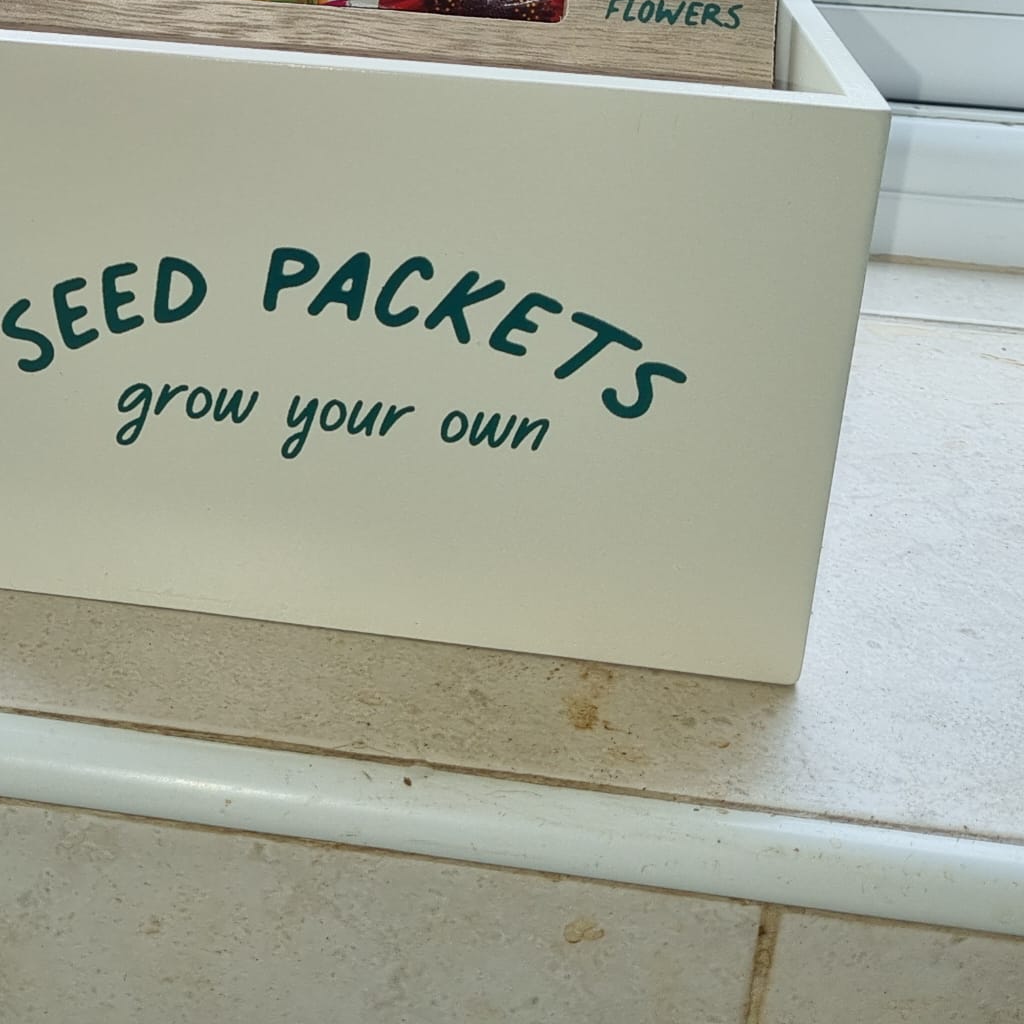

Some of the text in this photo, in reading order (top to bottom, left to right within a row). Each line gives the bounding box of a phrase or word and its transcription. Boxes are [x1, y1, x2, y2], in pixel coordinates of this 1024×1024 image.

[1, 247, 688, 420] SEED PACKETS
[115, 382, 551, 460] grow your own
